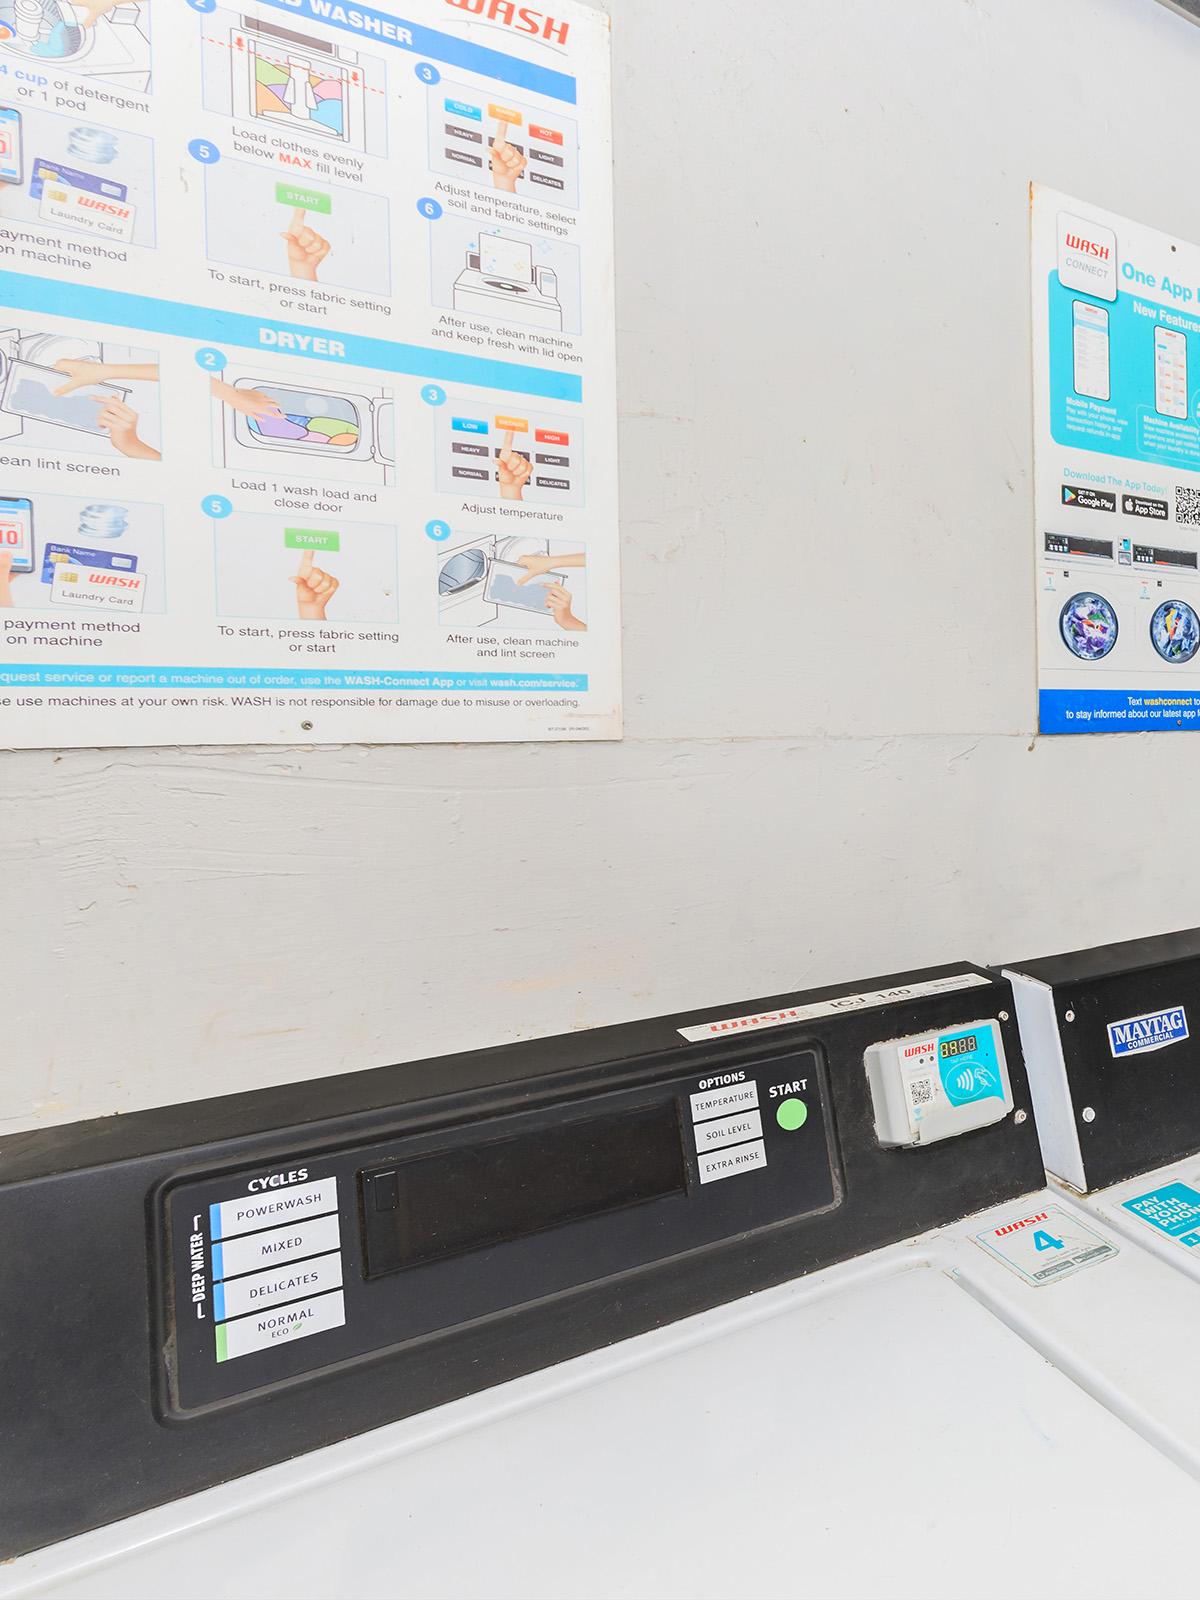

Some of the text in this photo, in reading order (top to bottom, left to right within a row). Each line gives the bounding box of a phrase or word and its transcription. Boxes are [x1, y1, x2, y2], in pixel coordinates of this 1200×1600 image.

[309, 0, 413, 46] WASHER
[444, 0, 570, 45] WASH
[422, 67, 433, 80] 3
[15, 69, 150, 114] cup of detergent
[17, 86, 87, 112] or 1 pod
[198, 146, 211, 158] 5
[232, 126, 364, 171] Load clothes evenly
[233, 141, 363, 183] below MAX fill level
[78, 196, 130, 218] WASH
[286, 191, 320, 205] START
[425, 203, 434, 215] 6
[50, 208, 124, 235] Laundry Card
[1066, 234, 1110, 260] WASH
[1065, 257, 1109, 279] CONNECT
[1122, 262, 1156, 288] One
[1161, 276, 1193, 303] App
[1133, 301, 1157, 320] New
[258, 327, 346, 358] DRYER
[204, 353, 216, 366] 2
[429, 389, 438, 401] 3
[462, 422, 478, 430] LOW
[544, 434, 560, 442] HIGH
[37, 457, 120, 476] lint screen
[458, 469, 568, 488] NORMAL DELICATES
[1063, 467, 1106, 485] Download
[1107, 475, 1123, 487] The
[1125, 478, 1141, 493] App
[1077, 495, 1114, 510] Google Play
[1135, 505, 1166, 517] App Store
[461, 503, 564, 522] Adjust temperature
[295, 534, 329, 545] START
[50, 544, 96, 557] Bank Name
[89, 574, 141, 589] WASH
[62, 590, 134, 606] Laundry Card
[4, 619, 141, 633] payment method
[6, 635, 103, 647] on machine
[44, 673, 579, 688] service or report a machine out of order, use the WASH-Connect App or visit wash.com/service.
[16, 696, 581, 709] use machines at your own risk. WASH is not responsible for damage due to misuse or overloading.
[1127, 696, 1143, 706] Text
[1144, 697, 1193, 706] washconnect
[1066, 710, 1074, 718] to
[1076, 710, 1092, 720] stay
[1093, 709, 1127, 718] informed
[1128, 709, 1148, 718] about
[1150, 710, 1161, 718] our
[1162, 709, 1181, 718] latest
[1182, 710, 1196, 719] app
[710, 1010, 798, 1033] WASH
[1113, 1012, 1183, 1045] MAYTAG
[904, 1042, 935, 1058] WASH
[1127, 1032, 1174, 1050] COMMERCIAL
[699, 1070, 746, 1090] OPTIONS
[768, 1078, 808, 1098] START
[695, 1090, 755, 1111] TEMPERATURE
[705, 1123, 752, 1141] SOIL LEVEL
[706, 1151, 760, 1173] EXTRA RINSE
[247, 1168, 309, 1192] CYCLES
[236, 1193, 322, 1221] POWERWASH
[1132, 1196, 1161, 1211] PAY
[1140, 1197, 1180, 1216] WITH
[1149, 1202, 1192, 1221] YOUR
[994, 1212, 1049, 1237] WASH
[261, 1237, 303, 1255] MIXED
[1033, 1230, 1064, 1252] 4
[190, 1232, 206, 1303] DEEP WATER
[249, 1272, 319, 1299] DELICATES
[257, 1308, 315, 1332] NORMAL
[271, 1327, 289, 1338] ECO
